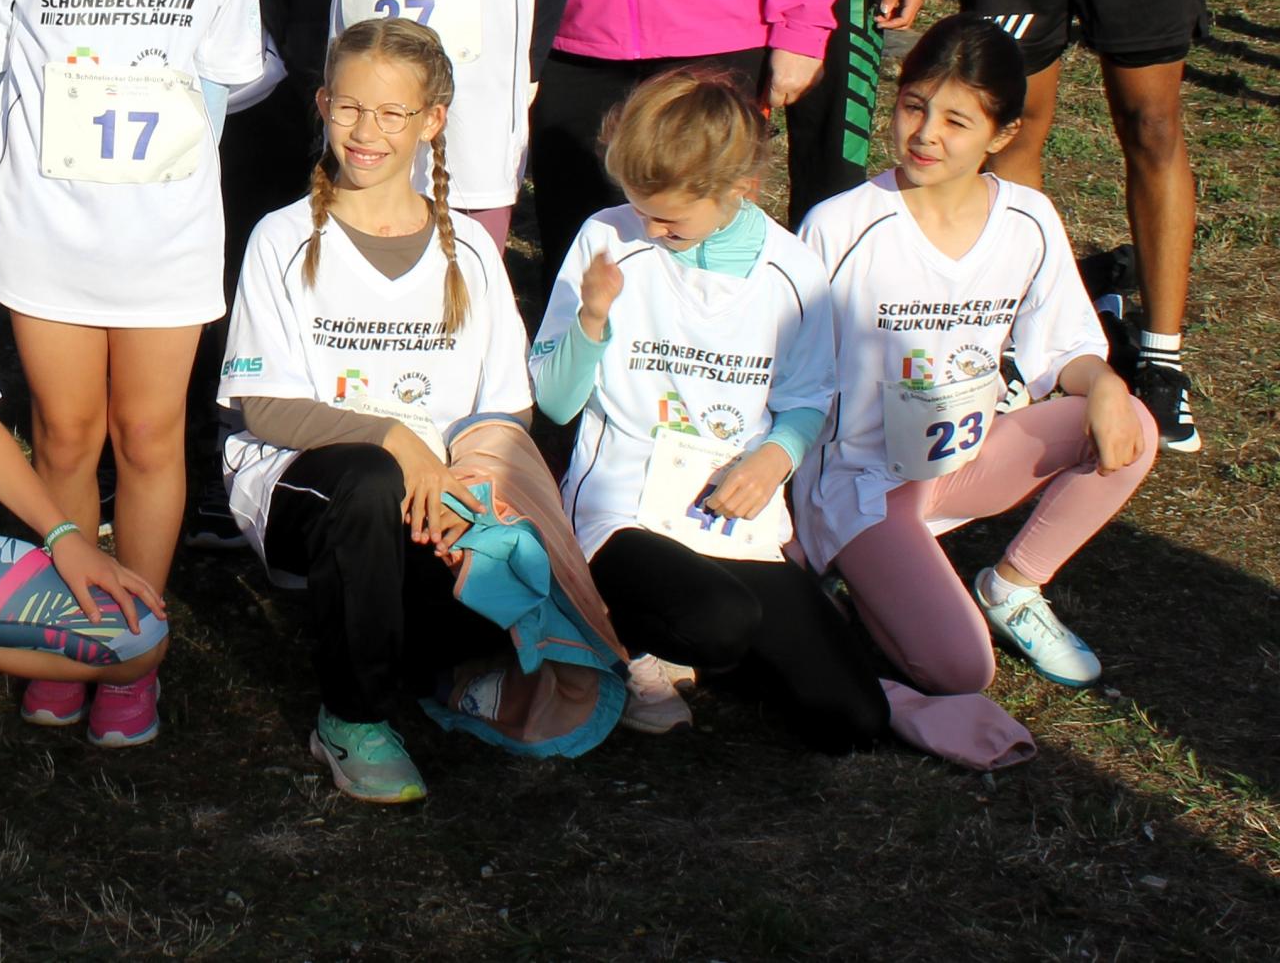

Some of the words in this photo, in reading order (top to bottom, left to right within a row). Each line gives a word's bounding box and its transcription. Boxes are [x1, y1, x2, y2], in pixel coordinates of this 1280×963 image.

[55, 8, 194, 28] ZUKUNFTSLÄUFER
[93, 109, 160, 161] 17
[878, 300, 992, 316] SCHÖNEBEKER
[313, 317, 432, 335] SCHÖNEBECKER
[893, 312, 1013, 331] ZUKUNFSLÄUFER
[327, 334, 457, 352] ZUKUNFTSLÄUFER
[631, 339, 743, 368] SCHÖNEBECKER
[646, 358, 770, 385] ZUKUNFTSLÄUFER
[926, 411, 983, 462] 23
